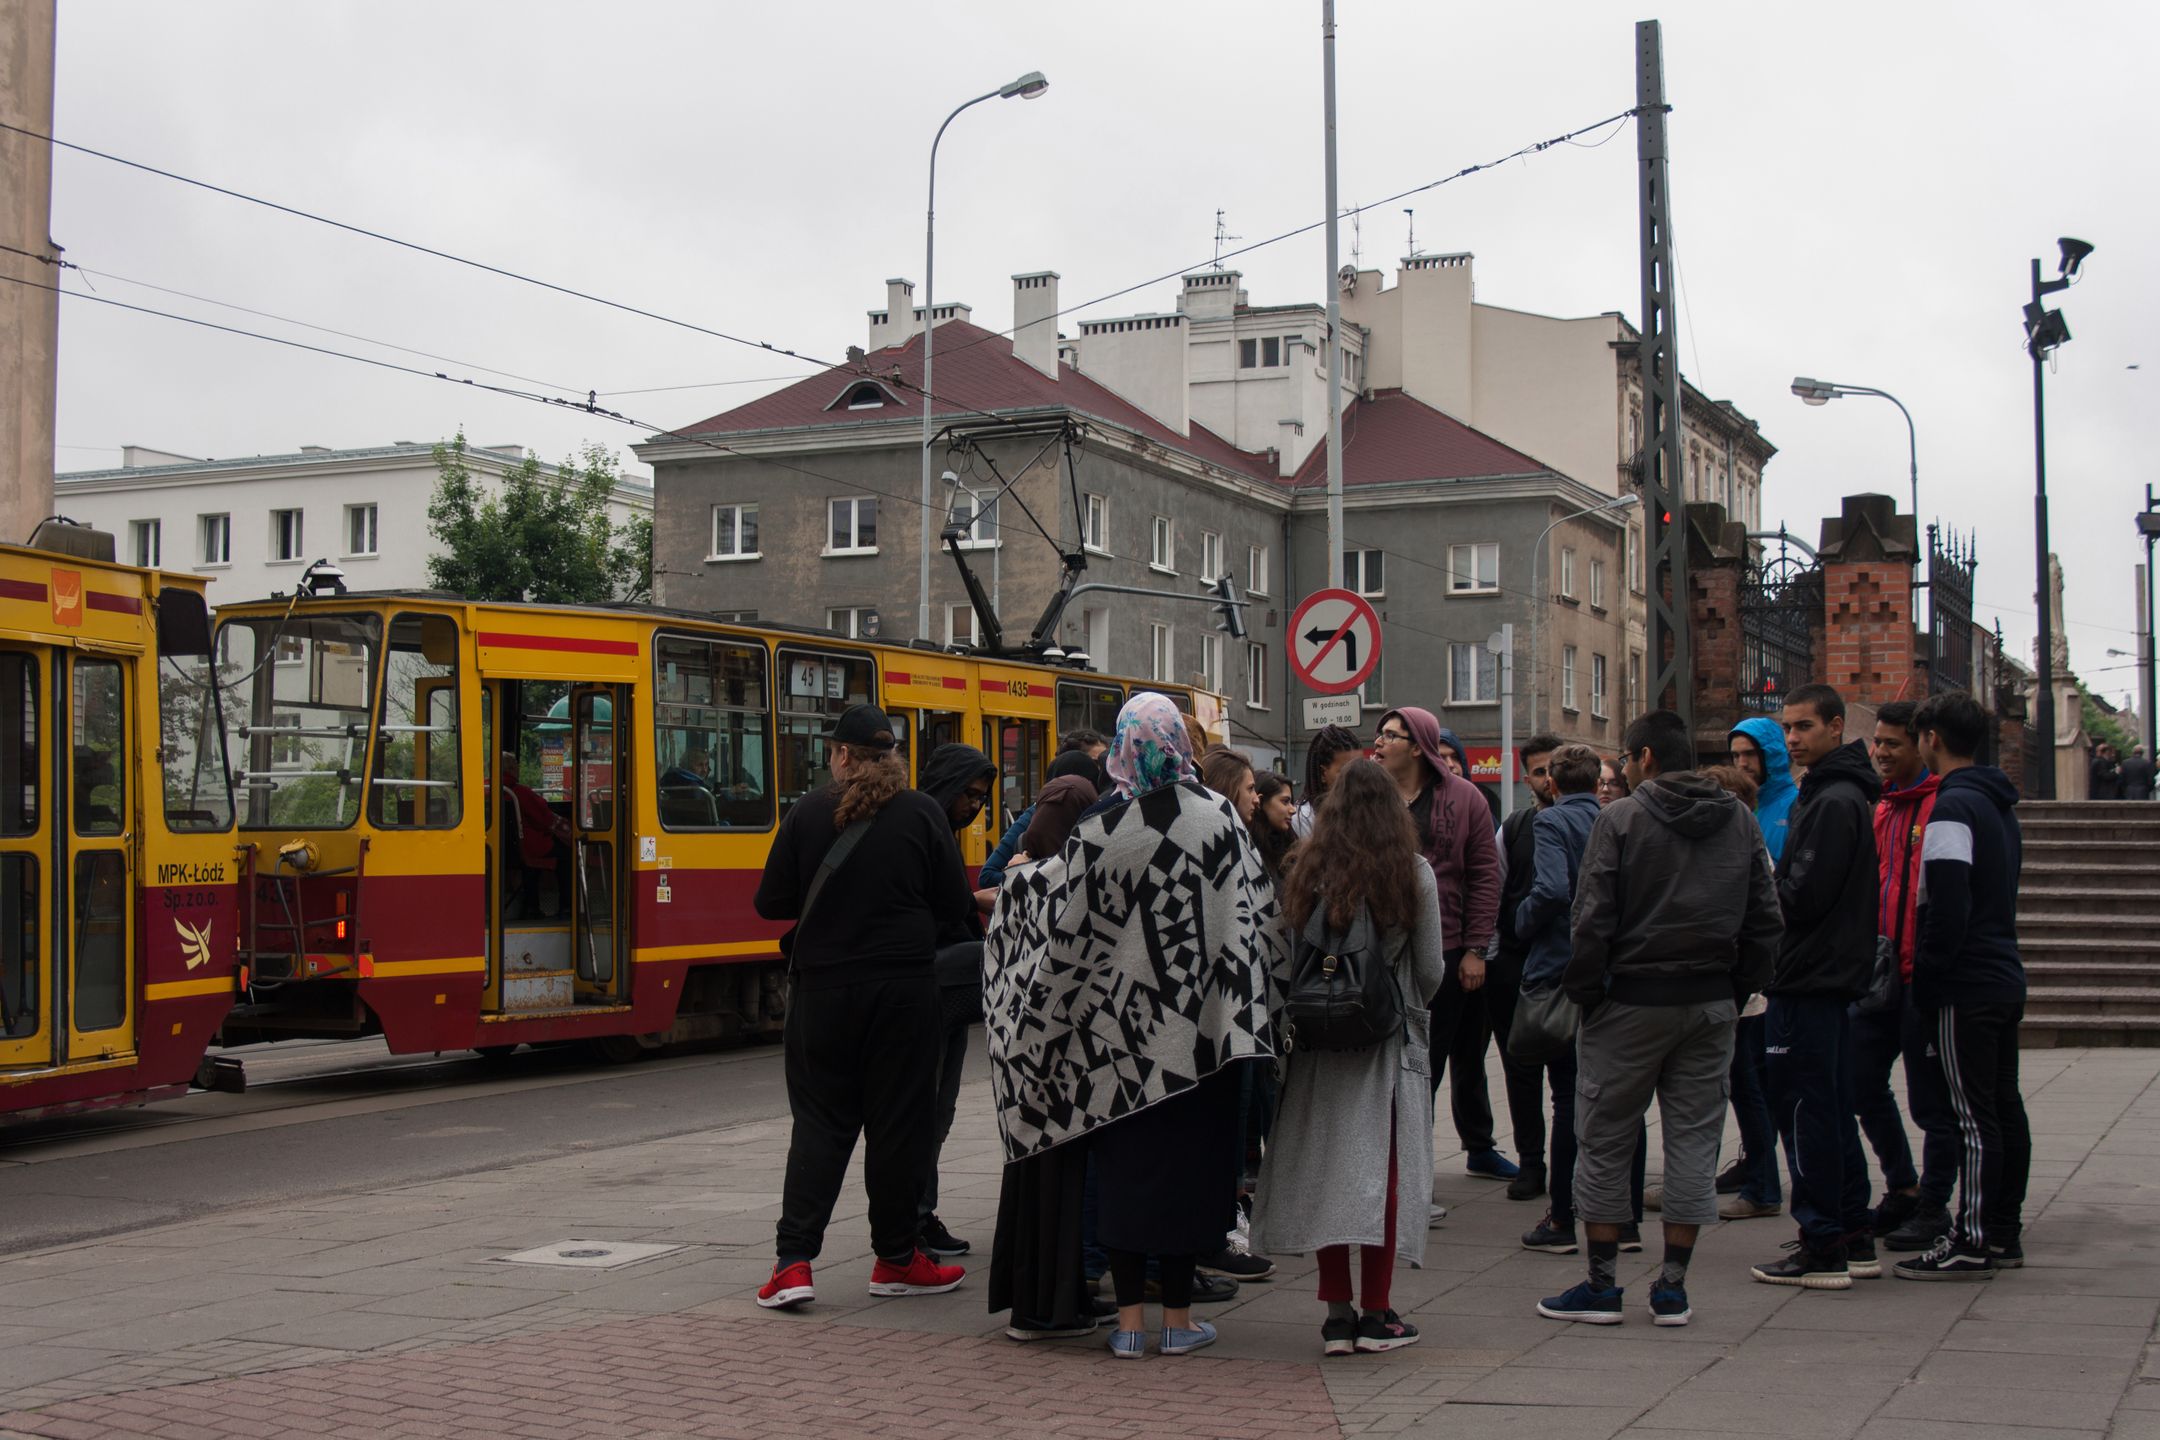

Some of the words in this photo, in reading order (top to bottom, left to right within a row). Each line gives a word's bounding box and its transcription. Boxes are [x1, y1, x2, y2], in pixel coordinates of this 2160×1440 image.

[801, 666, 814, 688] 45
[1007, 679, 1029, 698] 1435
[1320, 700, 1350, 710] godzinach
[1471, 764, 1502, 775] Bene
[158, 862, 225, 884] MPK-Łódź
